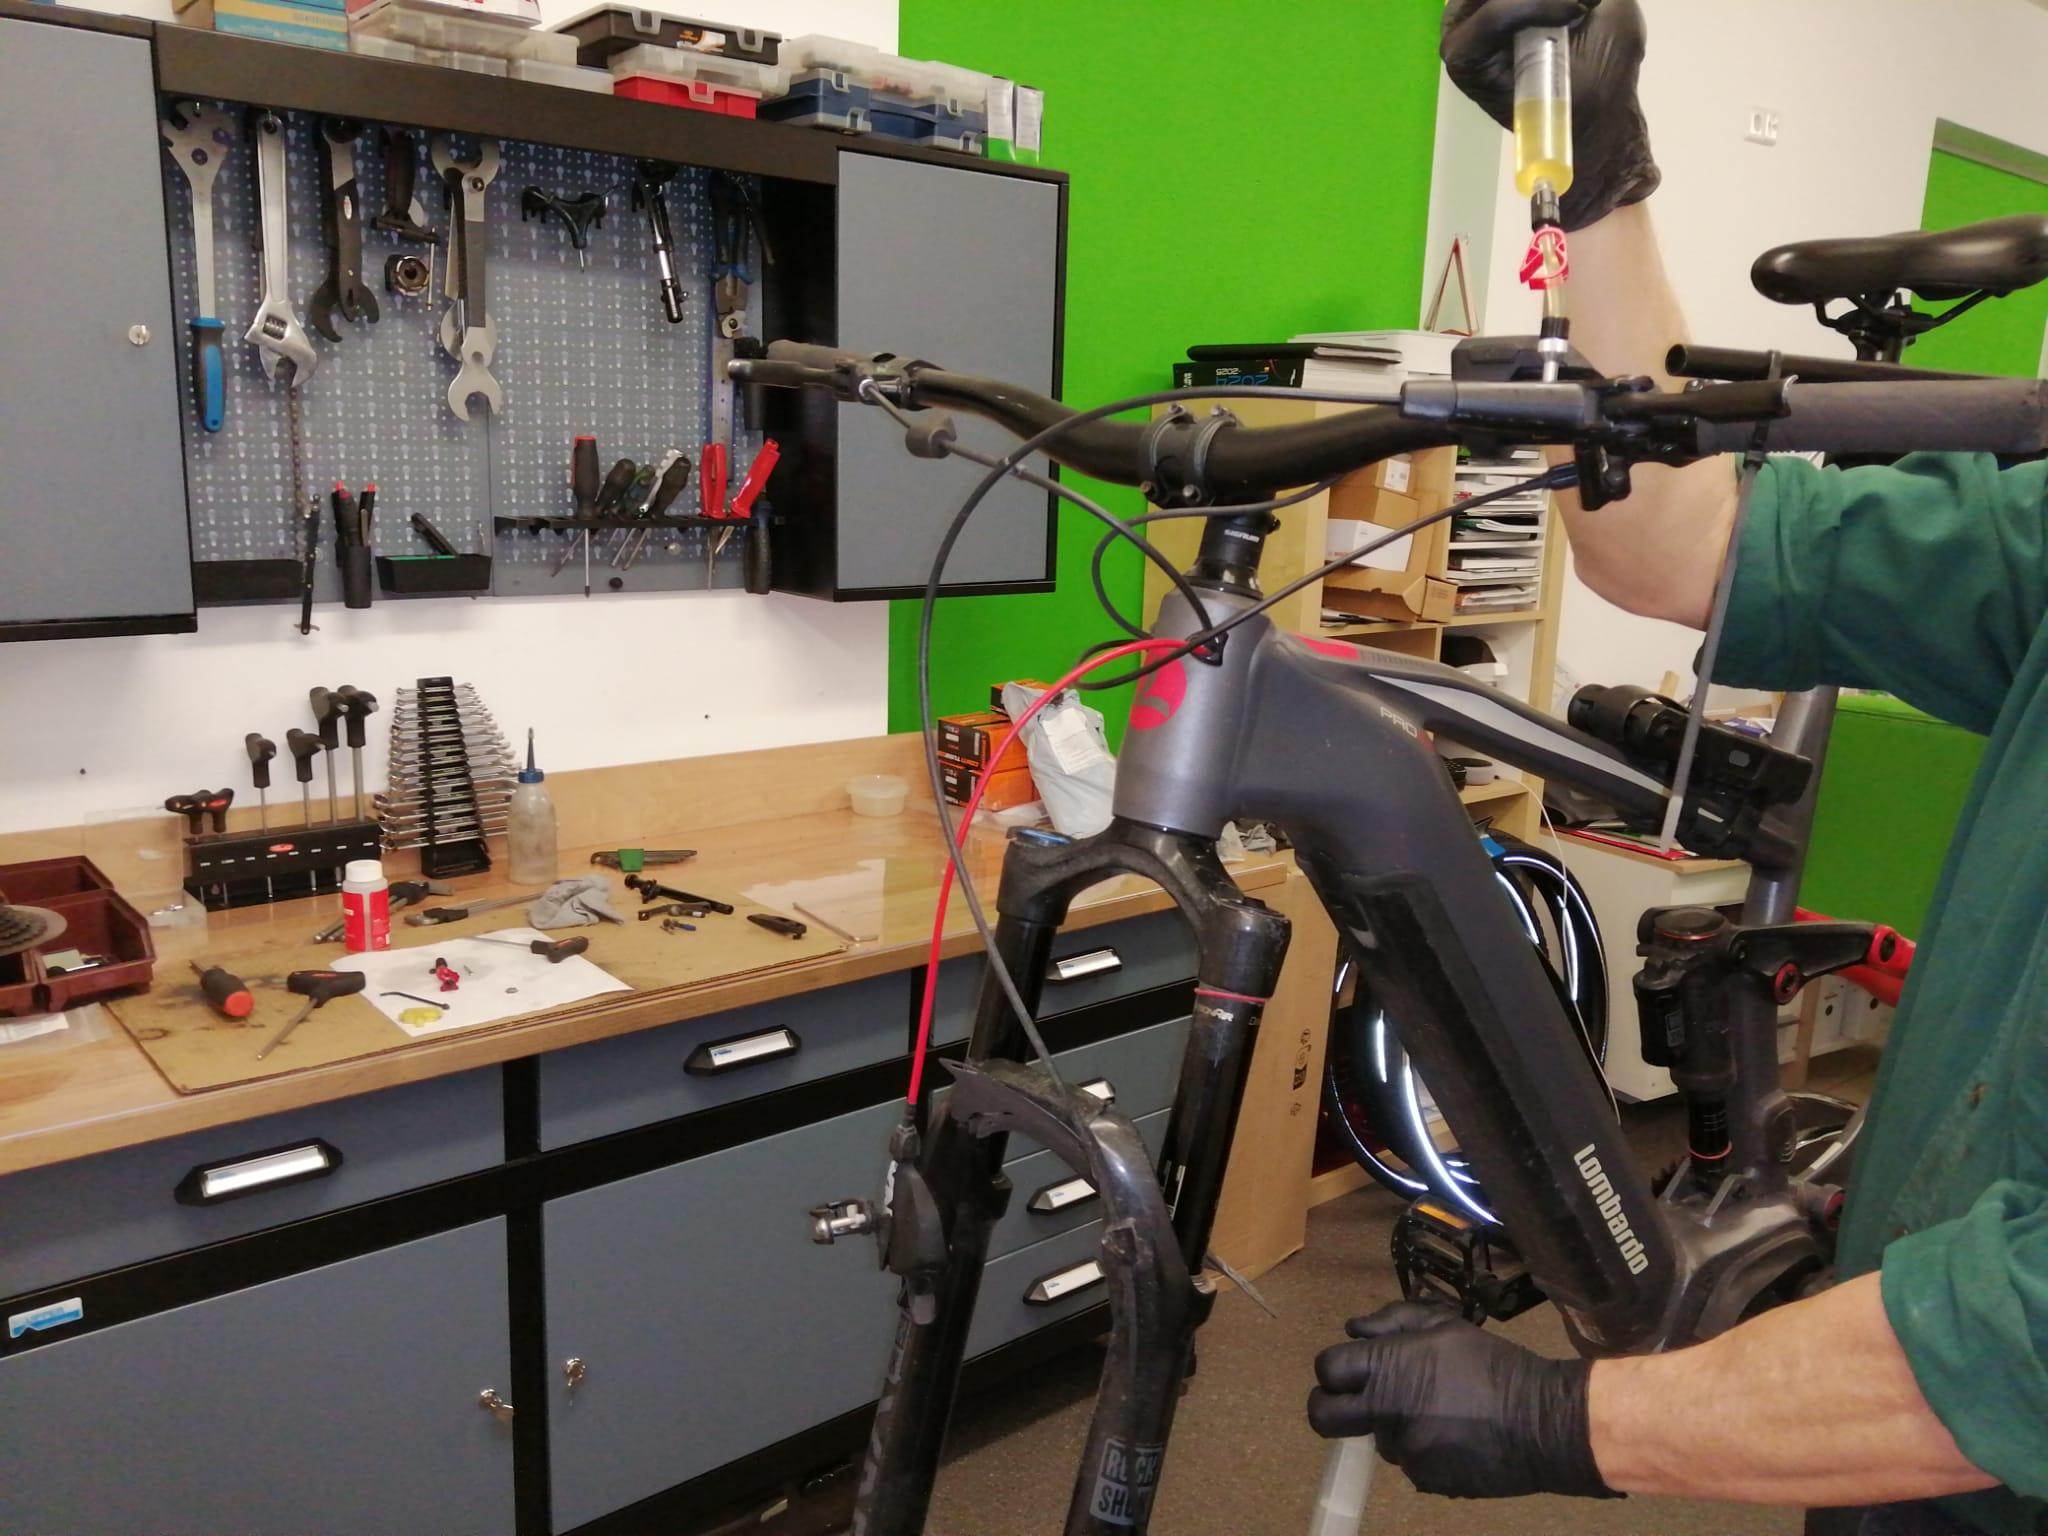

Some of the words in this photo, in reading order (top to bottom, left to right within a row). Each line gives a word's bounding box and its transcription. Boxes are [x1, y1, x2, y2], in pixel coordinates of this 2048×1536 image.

[1380, 706, 1418, 738] PRO
[1573, 1143, 1649, 1275] Lombardo
[1098, 1484, 1149, 1518] SH
